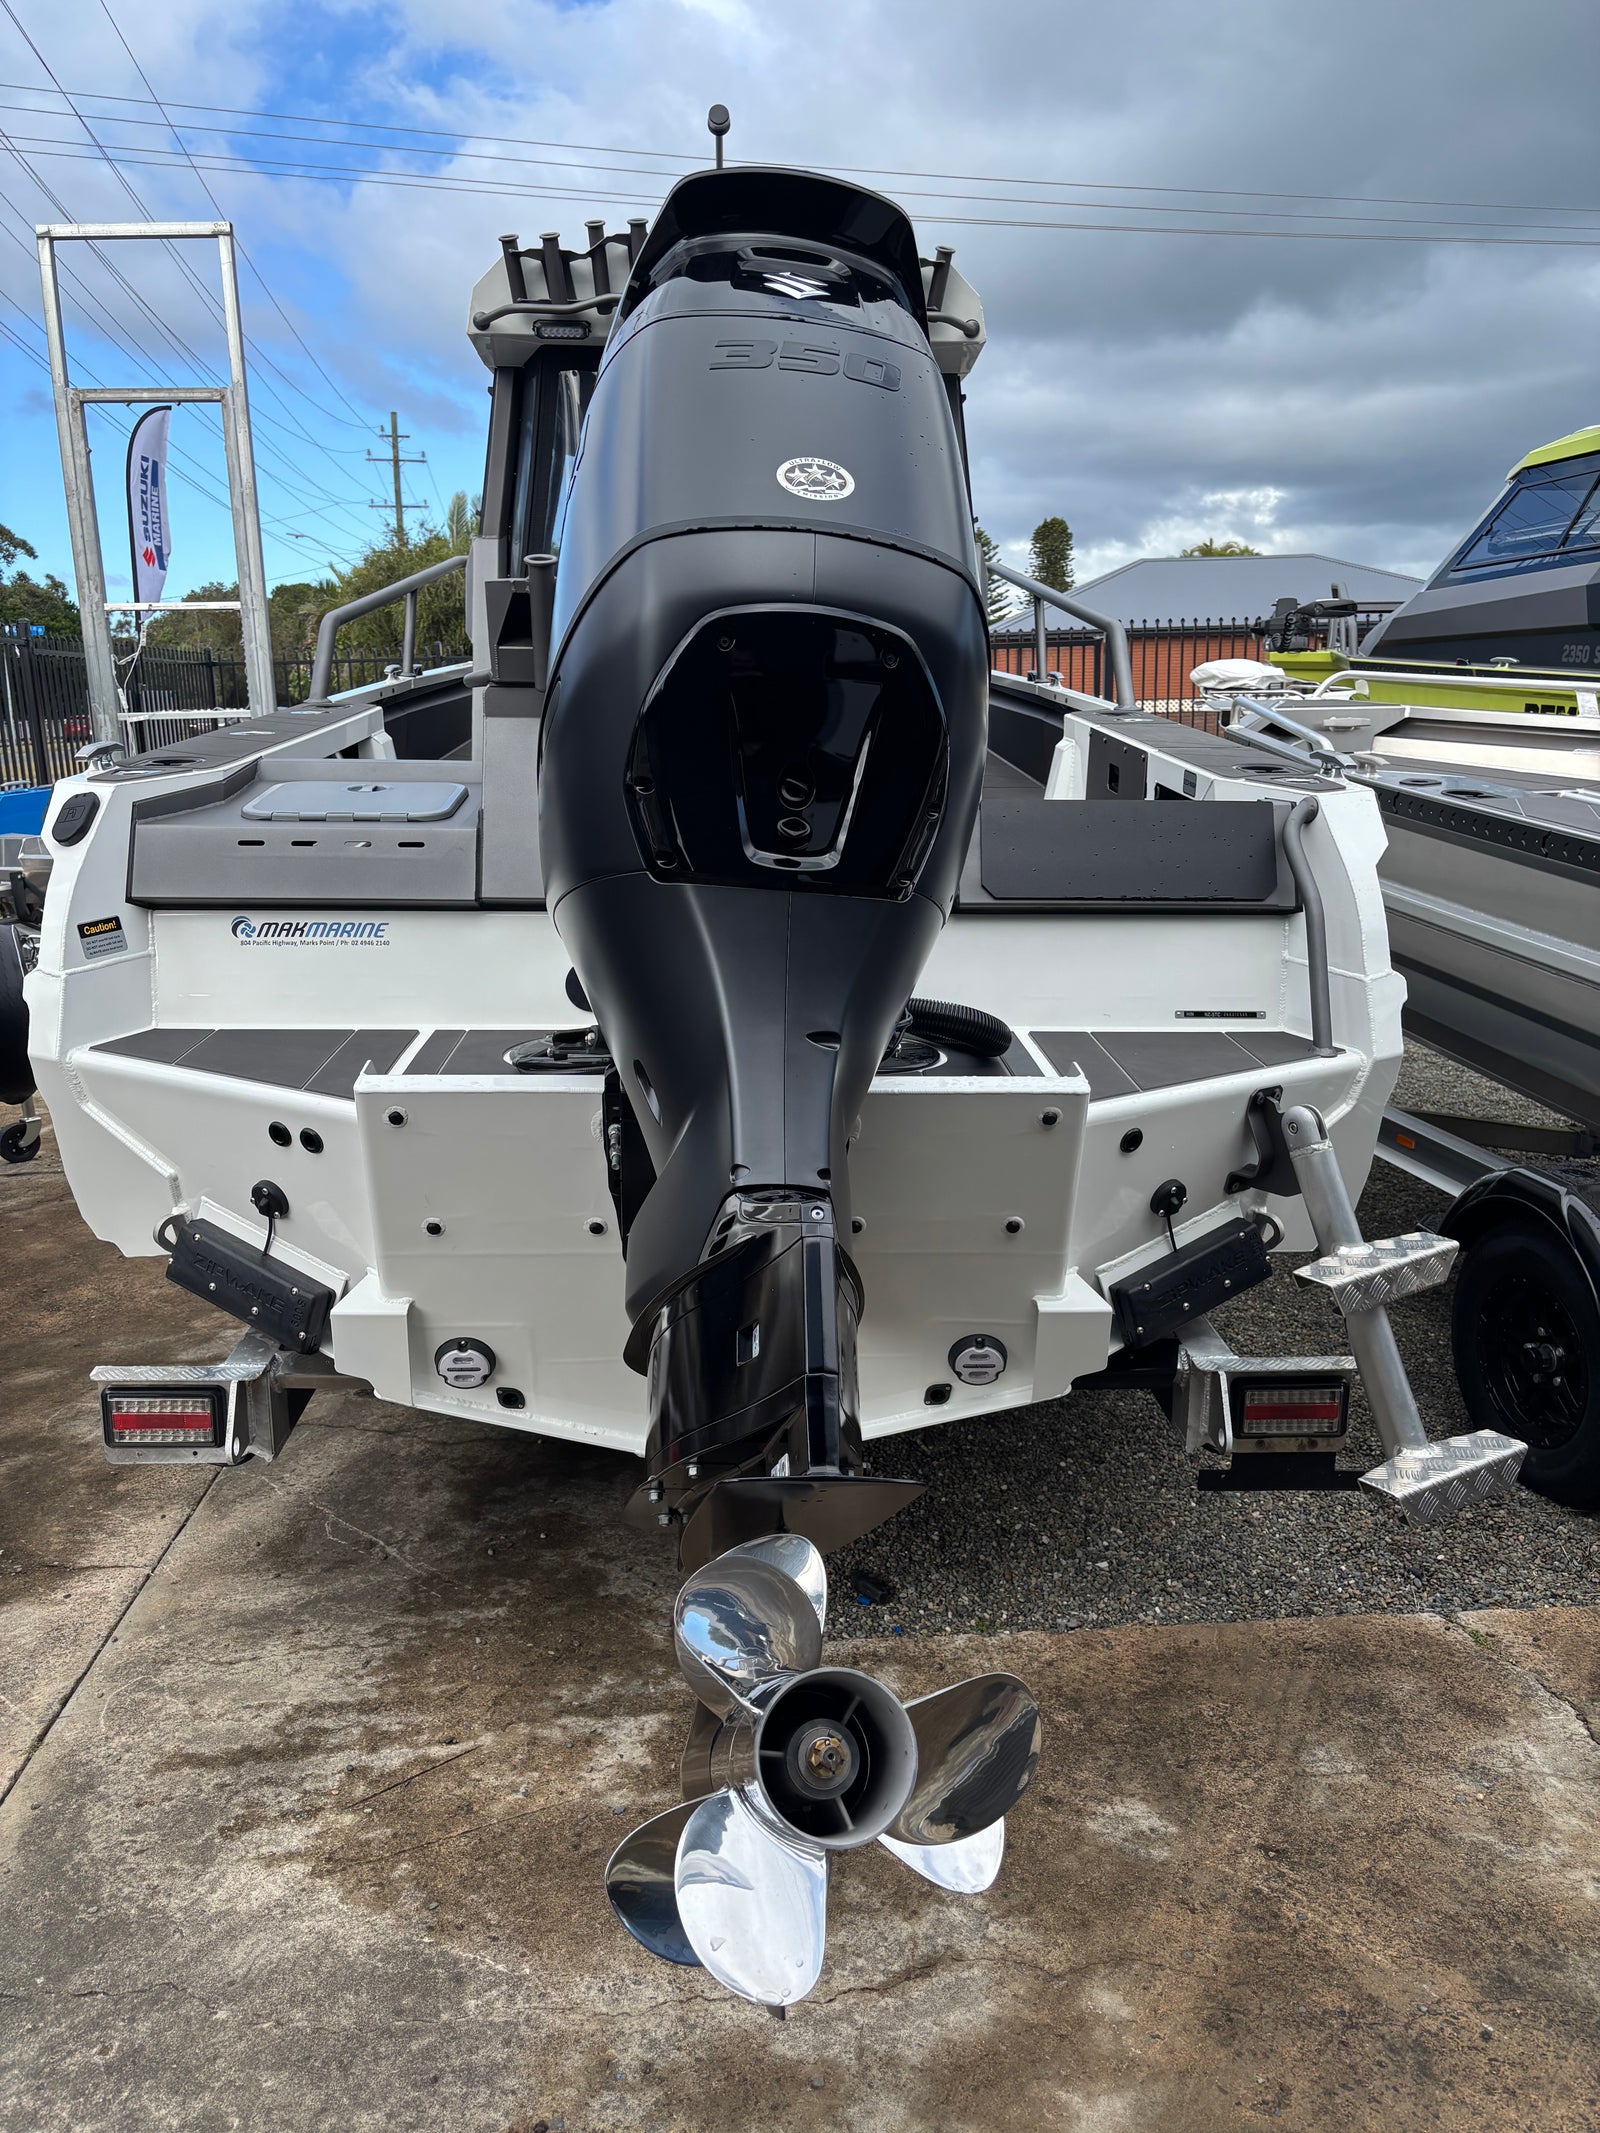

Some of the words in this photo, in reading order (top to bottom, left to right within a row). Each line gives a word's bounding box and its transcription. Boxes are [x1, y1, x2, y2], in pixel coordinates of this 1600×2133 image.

[709, 340, 901, 392] 350
[140, 455, 151, 543] SUZUKI
[150, 485, 162, 546] MARINE
[1562, 644, 1590, 664] 2350
[83, 920, 117, 935] Caution!
[256, 922, 389, 938] MAKMARINE
[272, 939, 299, 947] Highway,
